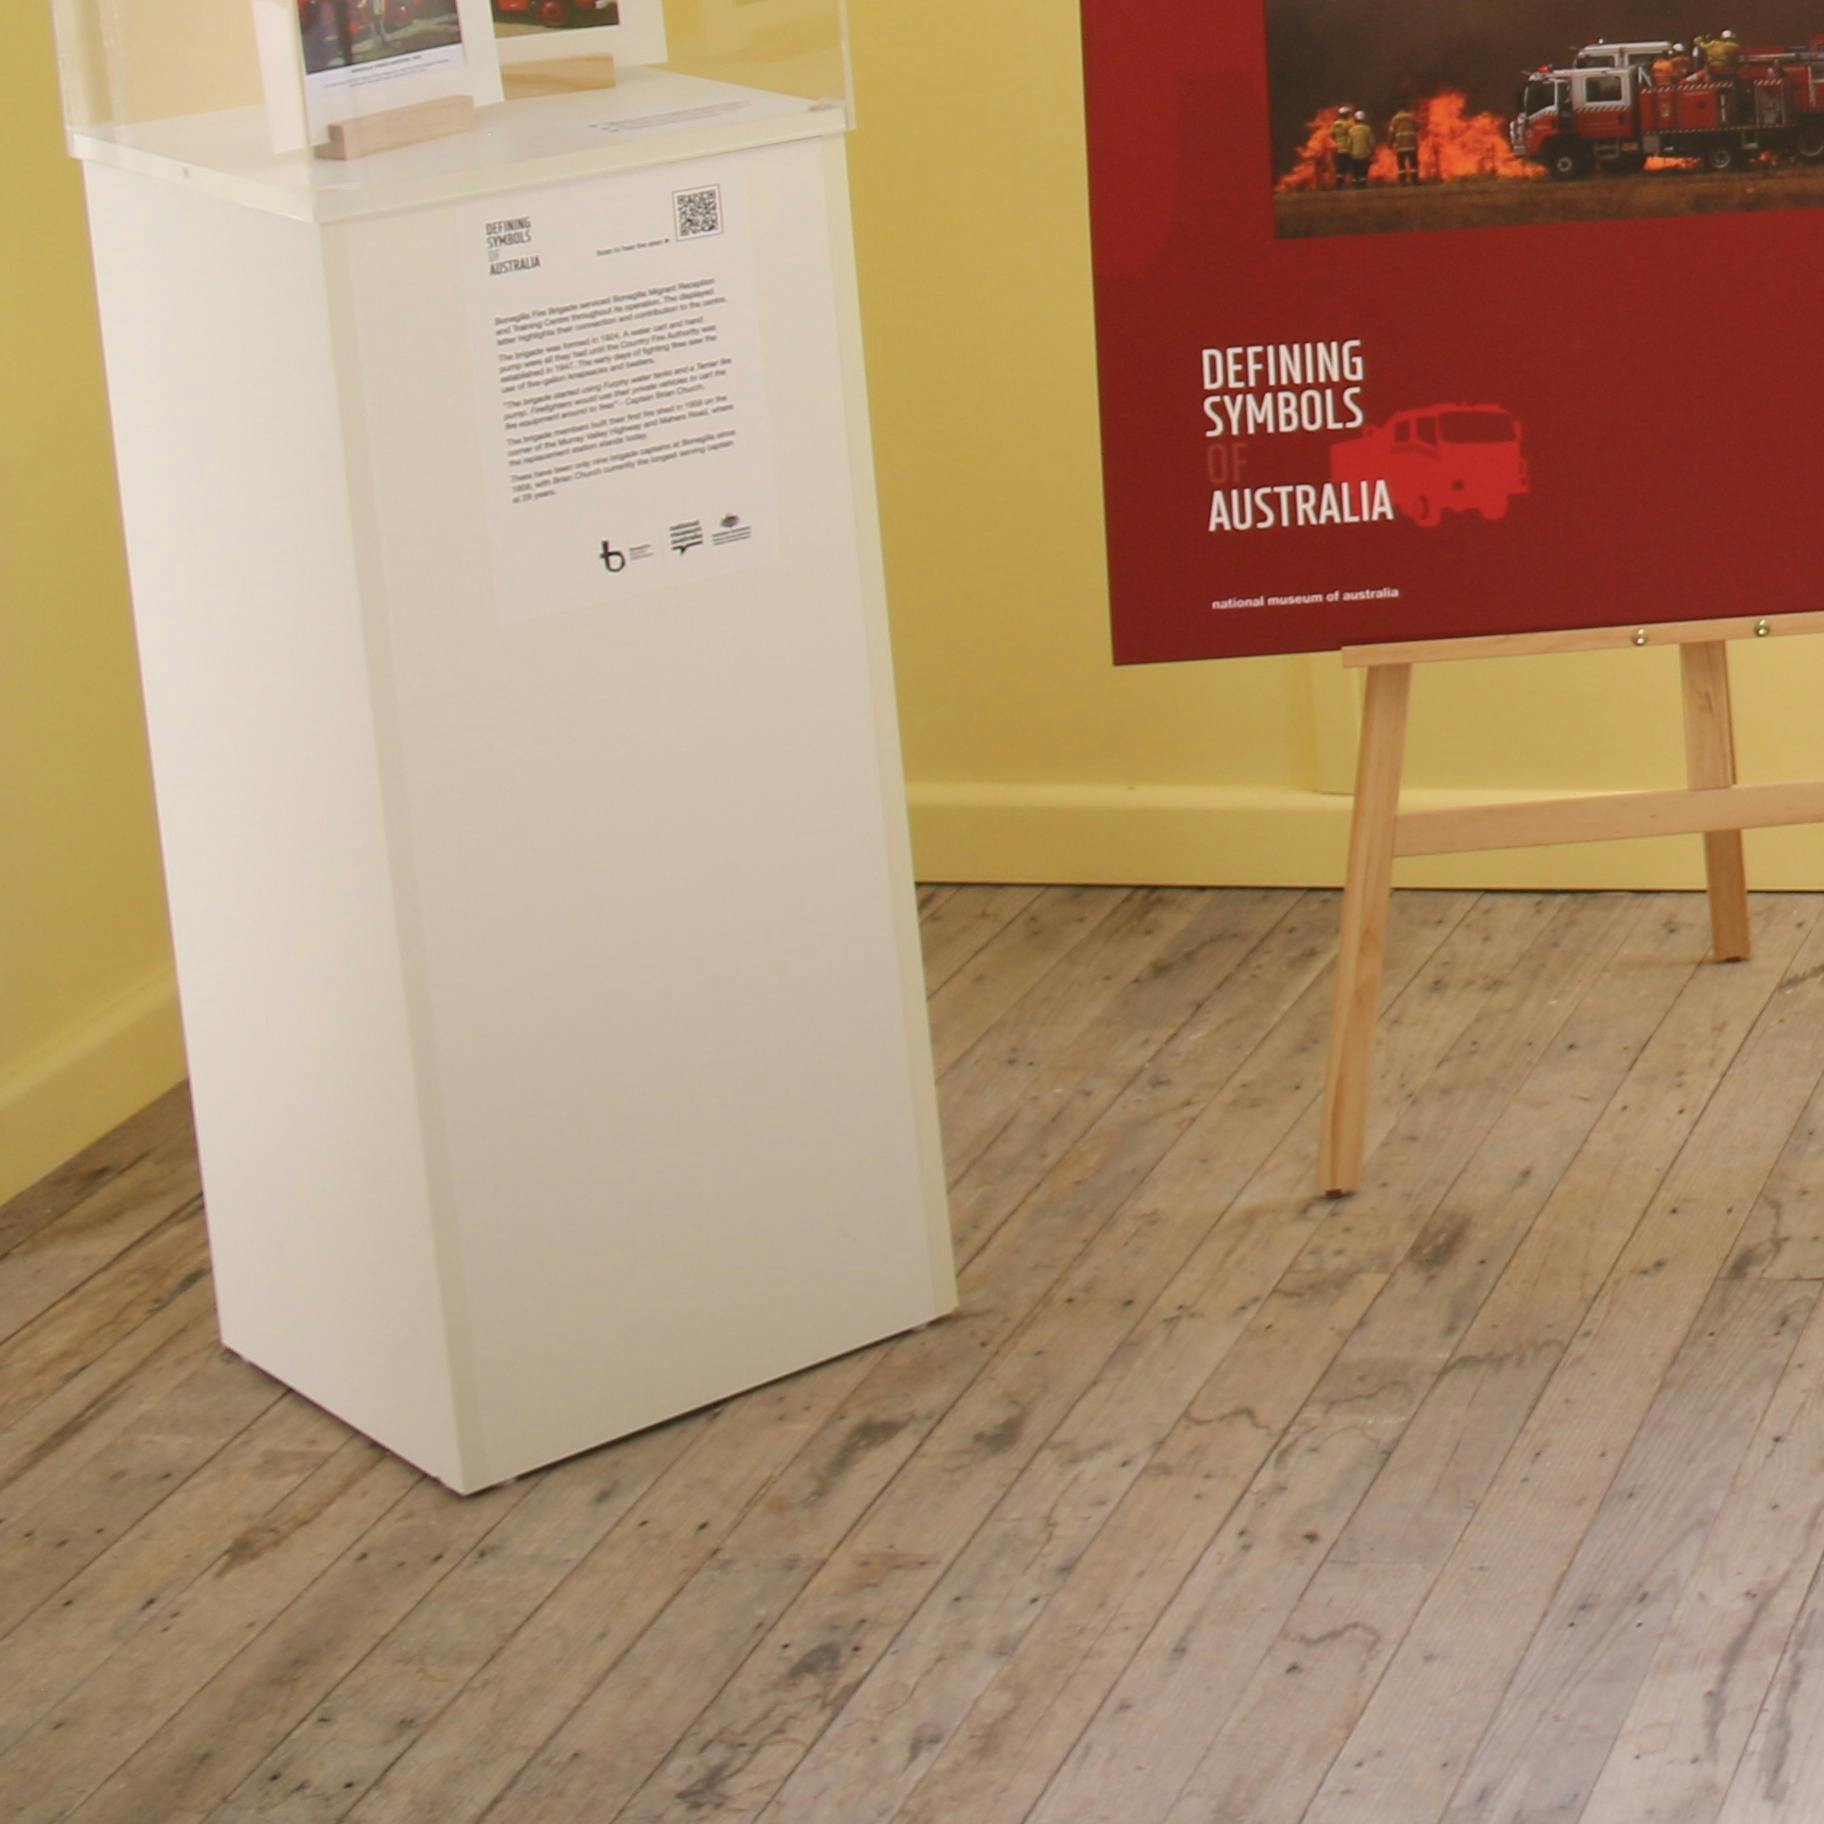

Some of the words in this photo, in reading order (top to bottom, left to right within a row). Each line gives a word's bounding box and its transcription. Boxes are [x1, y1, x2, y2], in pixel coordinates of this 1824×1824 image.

[485, 217, 532, 236] DEFINING
[487, 230, 532, 249] SYMBOLS
[489, 255, 541, 276] AUSTRALIA
[1201, 339, 1364, 391] DEFINING
[1204, 386, 1364, 438] SYMBOLS
[1207, 443, 1248, 484] OF
[1208, 479, 1394, 533] AUSTRALIA
[1212, 596, 1264, 609] national
[1268, 594, 1323, 605] museum
[1326, 591, 1339, 601] of
[1343, 588, 1399, 600] australia
